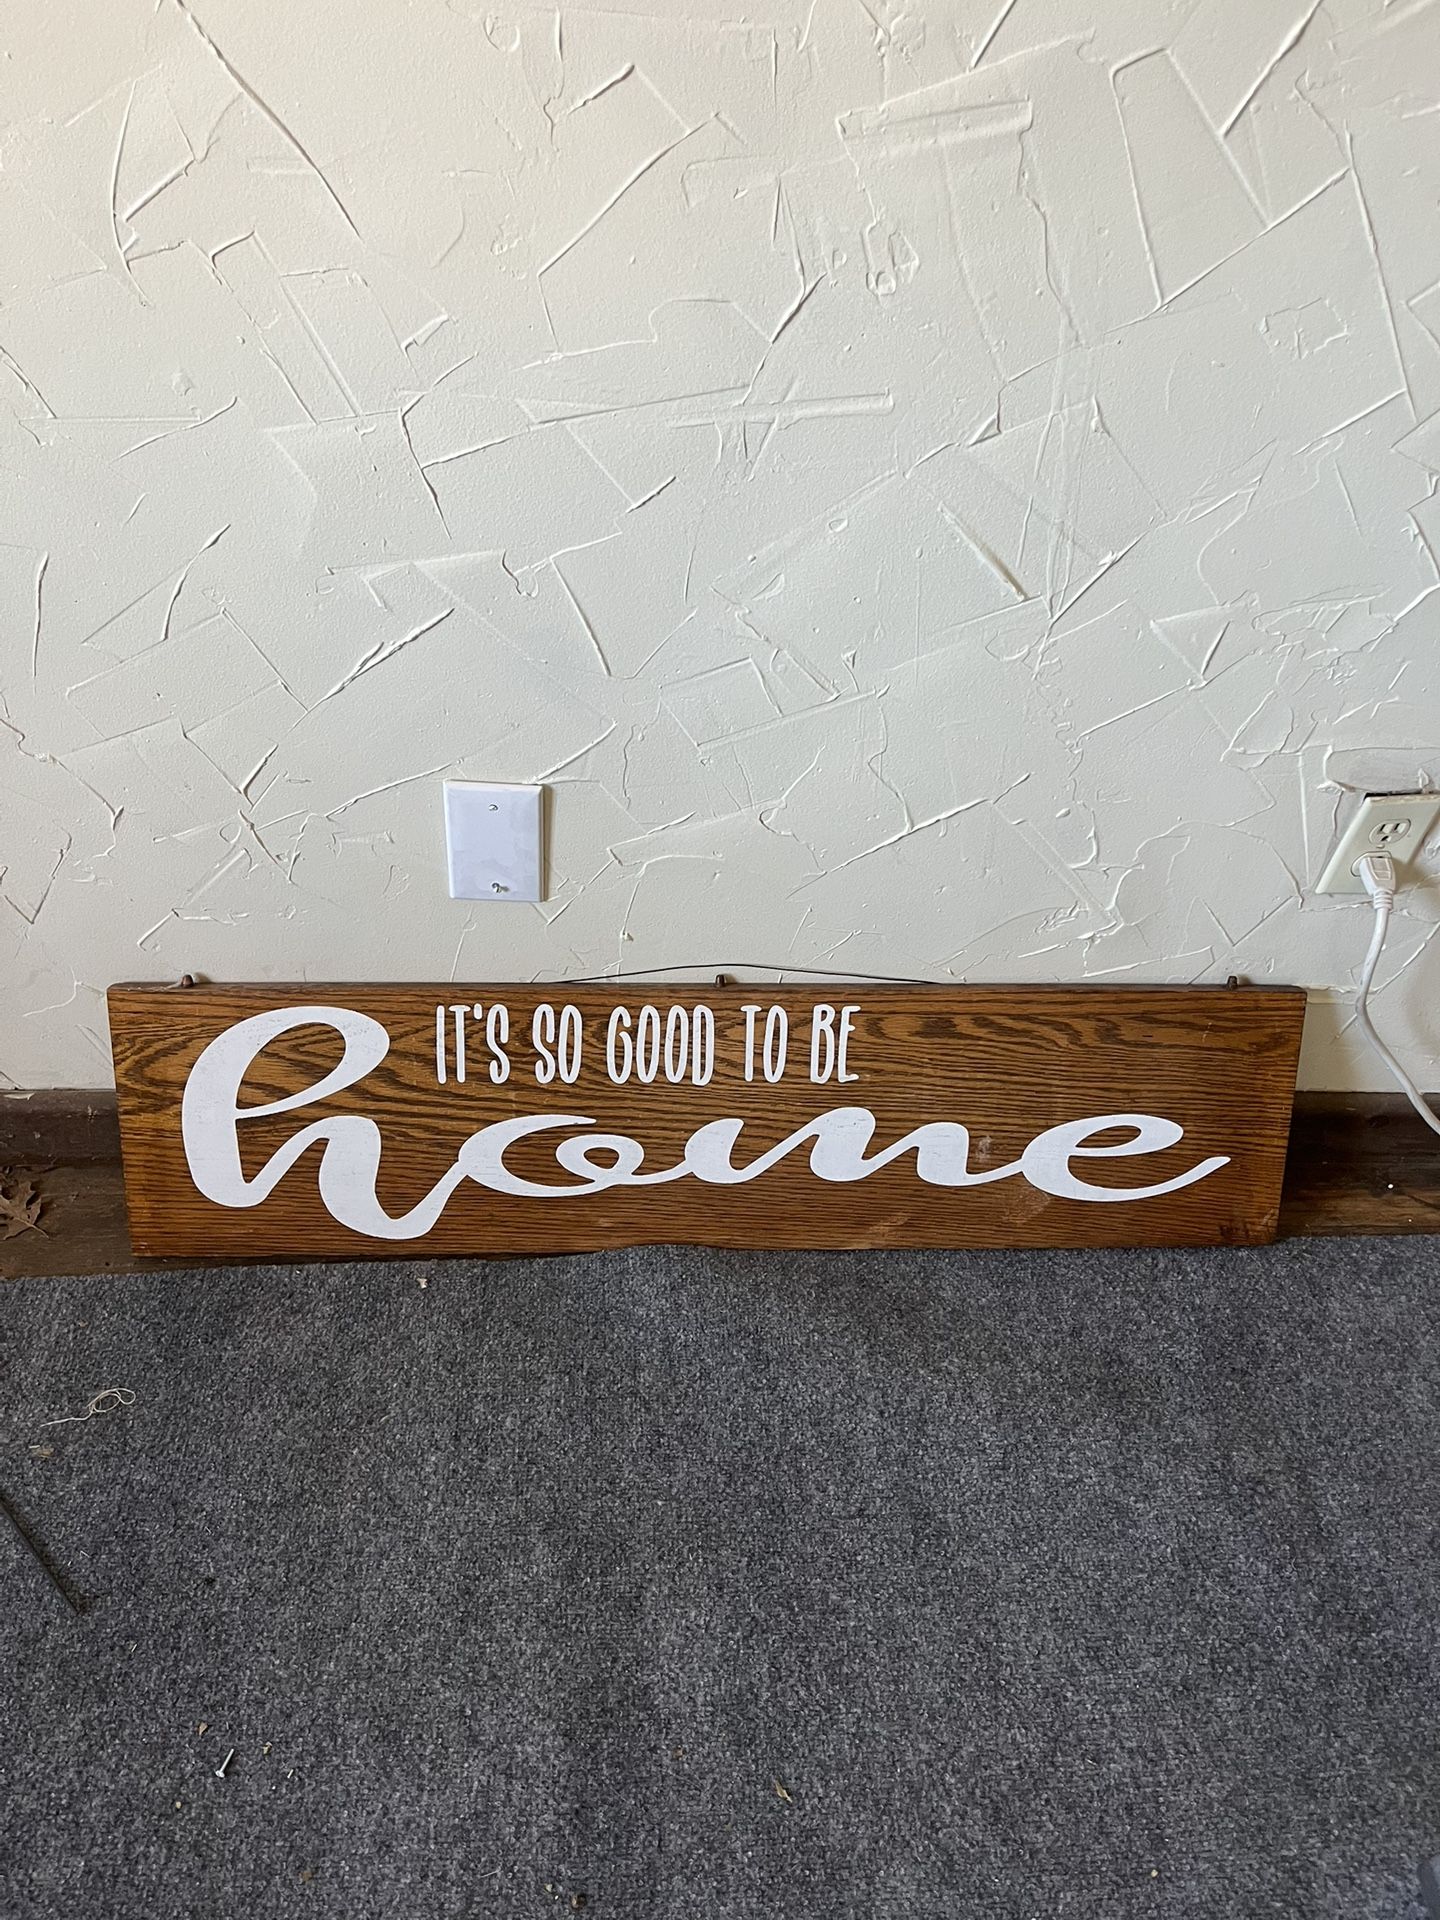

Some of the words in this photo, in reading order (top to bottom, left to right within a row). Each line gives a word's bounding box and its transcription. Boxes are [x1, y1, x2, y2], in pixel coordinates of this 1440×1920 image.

[181, 1005, 1231, 1241] home
[435, 1003, 511, 1085] IT'S
[531, 1003, 583, 1084] SO
[606, 1004, 715, 1087] GOOD
[740, 1004, 789, 1084] TO
[809, 1003, 862, 1085] BE
